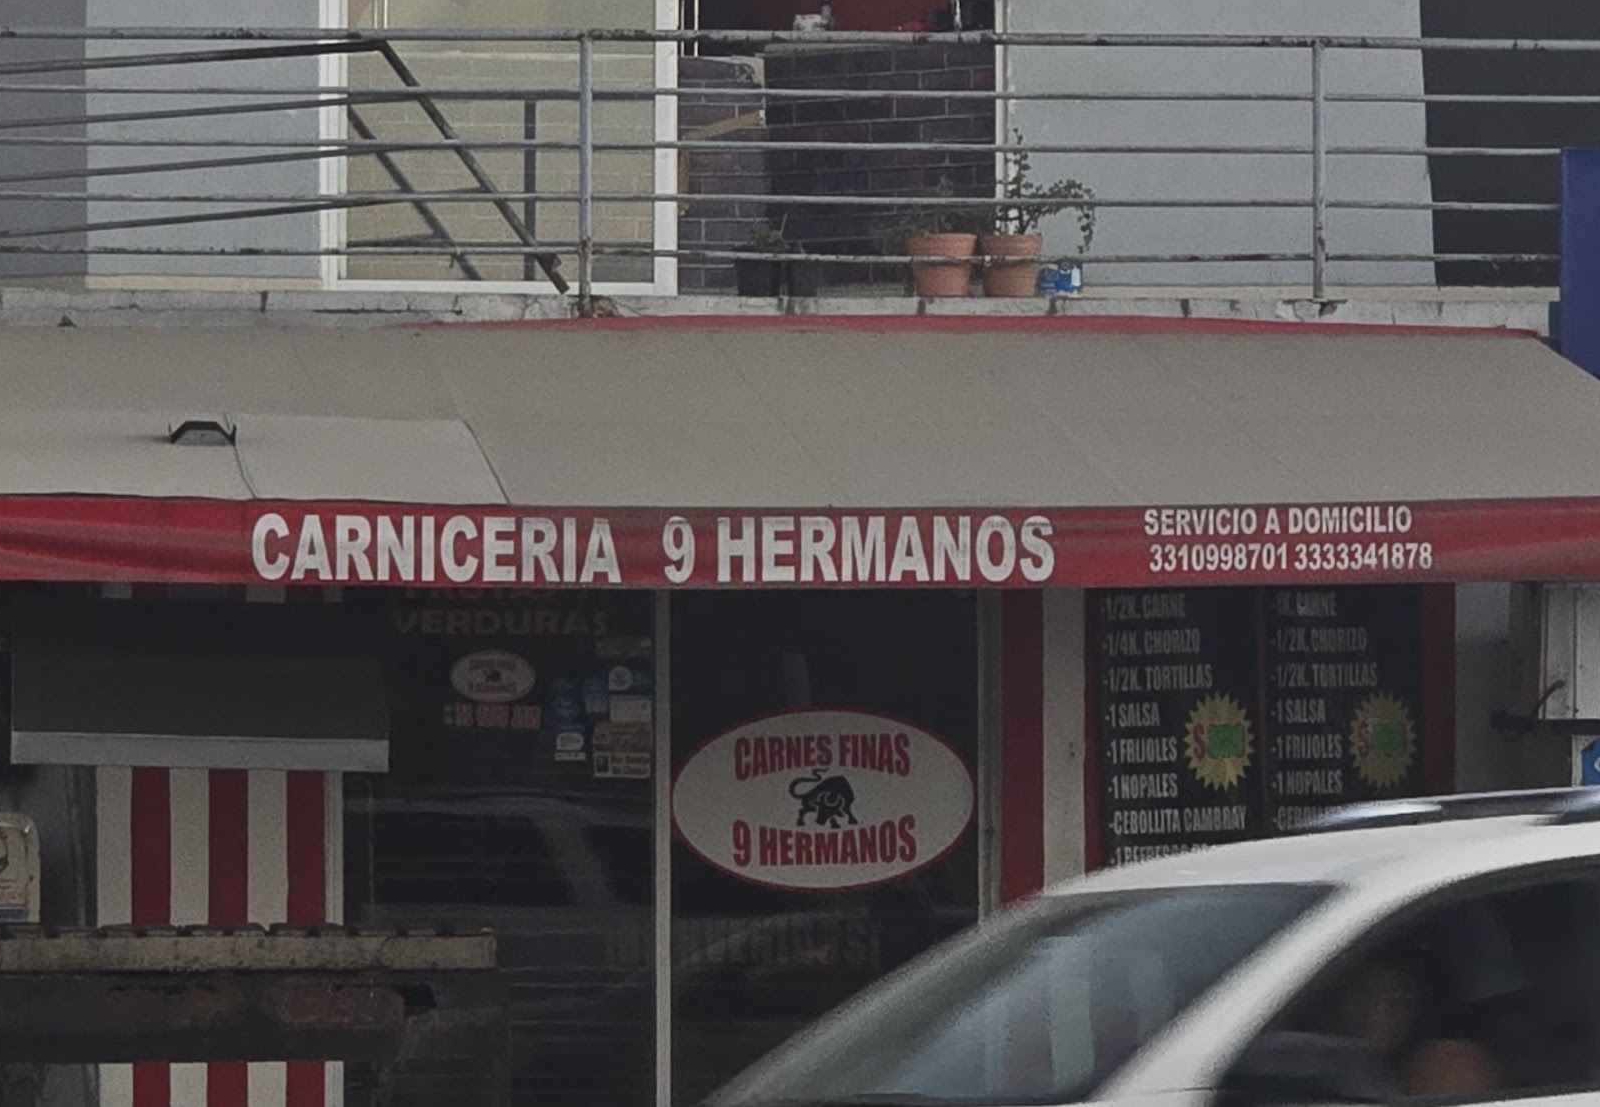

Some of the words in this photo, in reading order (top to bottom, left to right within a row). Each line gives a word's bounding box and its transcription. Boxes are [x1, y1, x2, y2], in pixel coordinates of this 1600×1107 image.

[1144, 507, 1258, 536] SERVICIO
[1264, 506, 1281, 535] A
[1288, 505, 1413, 534] DOMICILIO
[251, 512, 622, 584] CARNICERIA
[661, 515, 696, 584] 9
[716, 514, 1056, 583] HERMANOS
[1149, 542, 1288, 572] 3310998701
[1294, 541, 1433, 571] 3333341878
[1144, 663, 1213, 691] TORTILLAS
[1312, 662, 1379, 688] TORTILLAS
[1118, 702, 1161, 727] SALSA
[1285, 698, 1327, 724] SALSA
[734, 734, 833, 782] CARNES
[838, 732, 912, 778] FINAS
[1119, 737, 1178, 764] FRIJOLES
[1285, 734, 1343, 760] FRIJOLES
[1120, 771, 1178, 799] NOPALES
[732, 818, 751, 868] 9
[758, 814, 918, 867] HERMANOS
